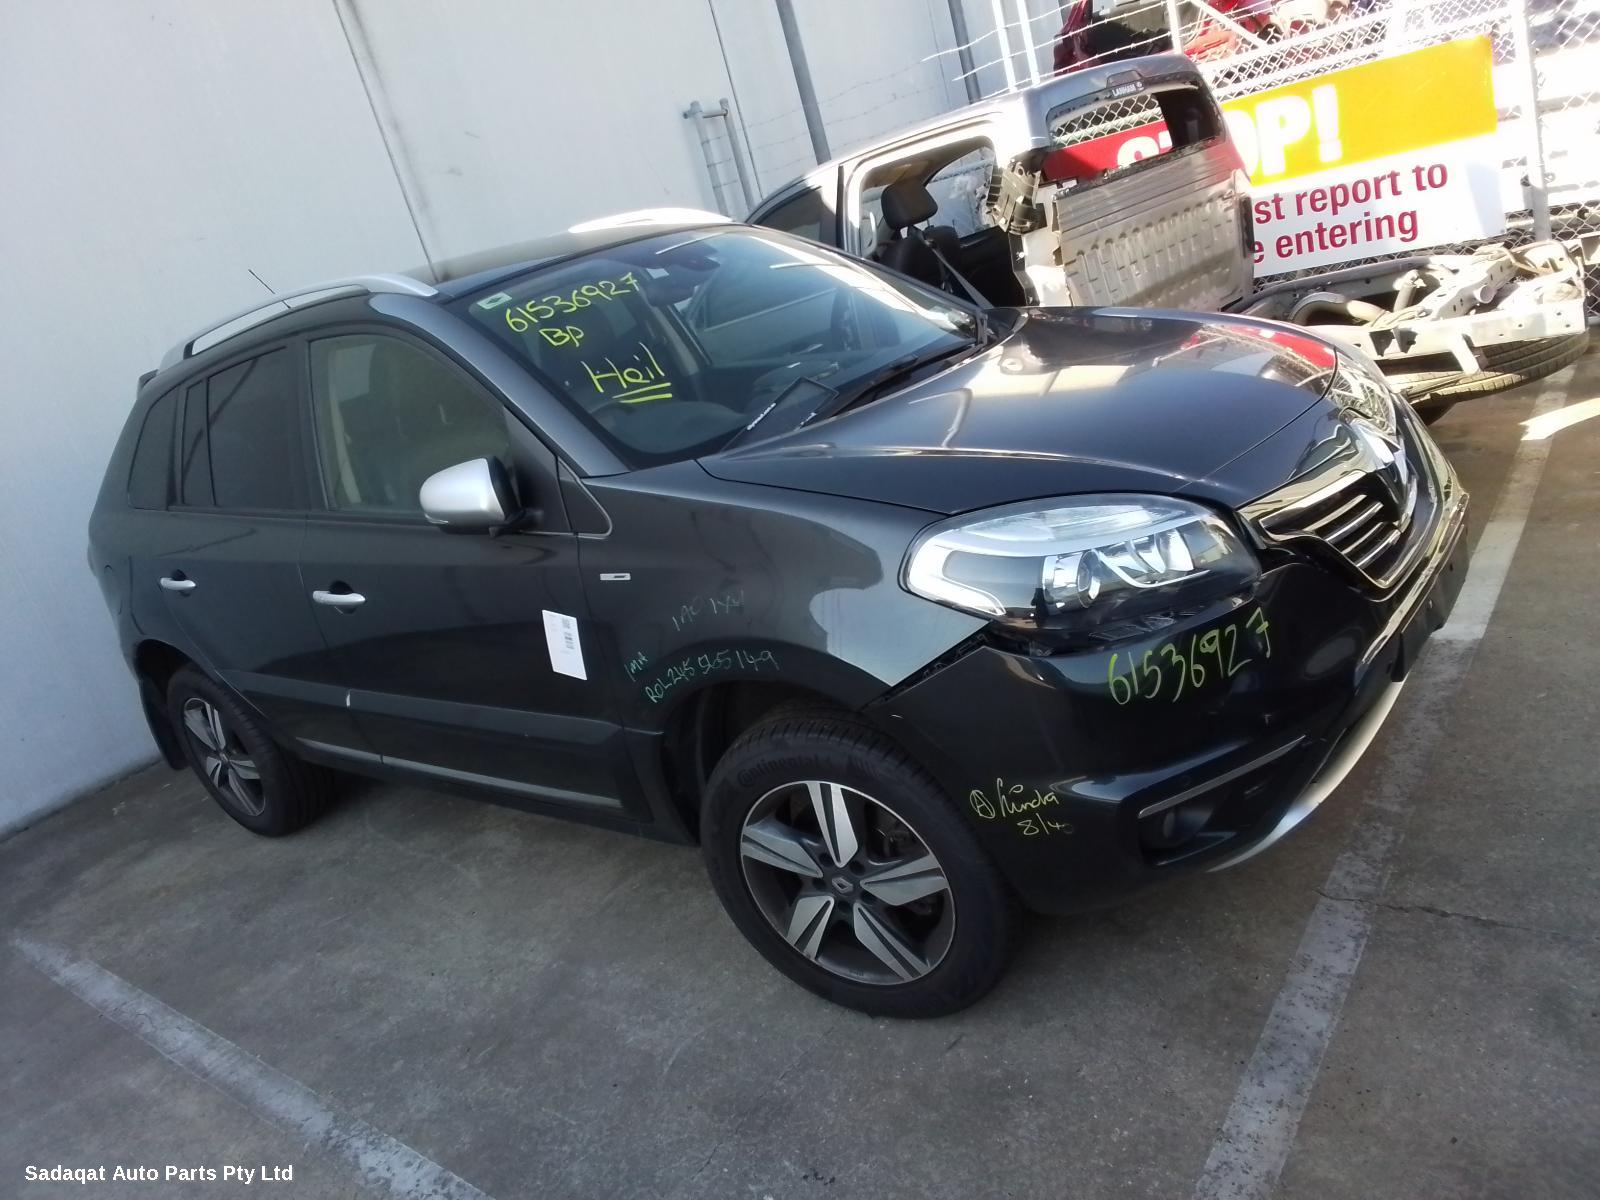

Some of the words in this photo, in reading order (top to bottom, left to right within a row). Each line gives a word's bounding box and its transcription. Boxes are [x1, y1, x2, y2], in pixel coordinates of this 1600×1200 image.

[1295, 170, 1403, 216] report
[1411, 163, 1449, 192] to
[1275, 210, 1419, 259] entering
[505, 271, 640, 333] 61536927
[1107, 606, 1271, 705] 61536927
